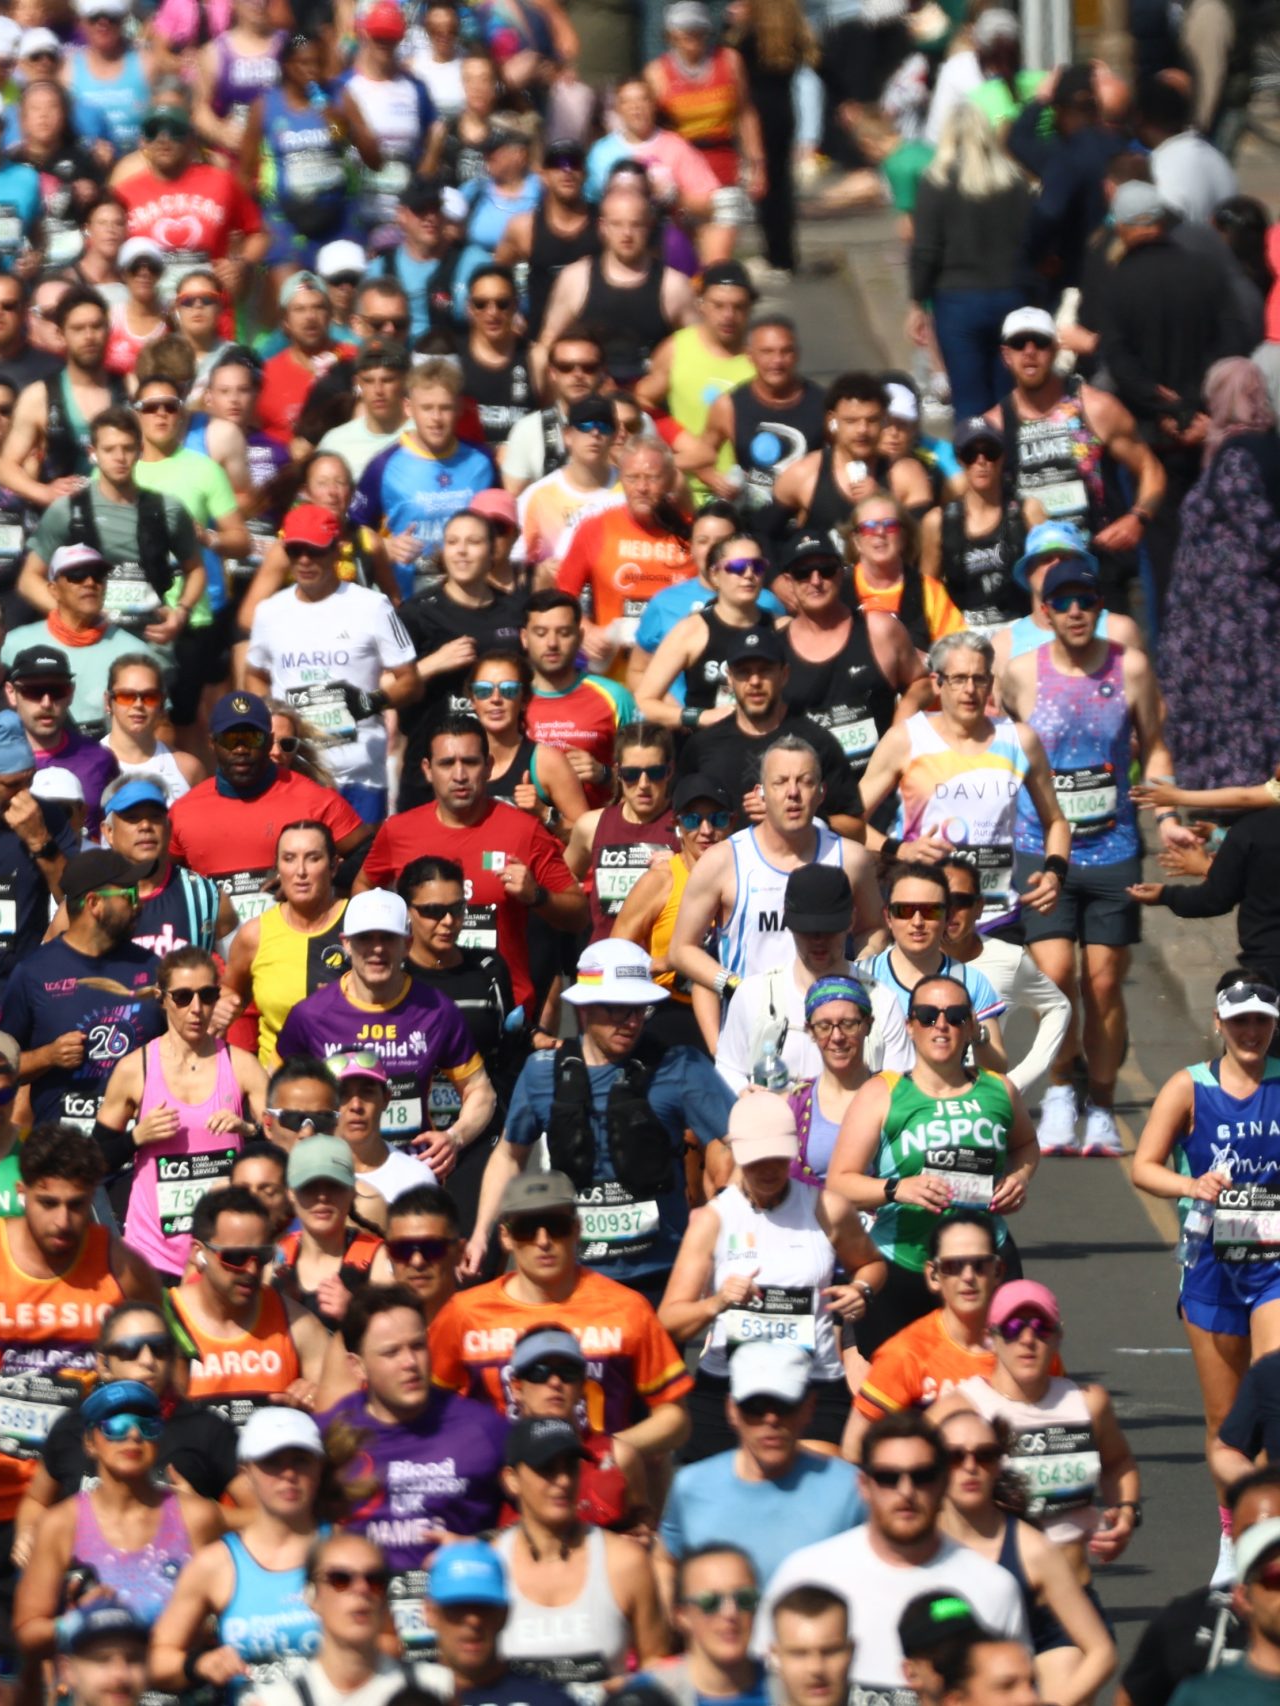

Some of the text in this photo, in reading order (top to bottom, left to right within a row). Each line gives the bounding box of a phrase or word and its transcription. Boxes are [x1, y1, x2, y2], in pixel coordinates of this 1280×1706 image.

[282, 650, 350, 669] MARIO
[287, 691, 309, 705] tcs
[450, 695, 473, 710] tc
[535, 730, 598, 738] Air Ambulance
[935, 780, 1018, 800] DAVID
[1054, 775, 1075, 790] cs
[601, 849, 627, 866] tcs
[356, 1023, 397, 1040] JOE
[89, 1024, 129, 1060] 26
[325, 1042, 407, 1058] WChild
[65, 1094, 95, 1117] tcs
[933, 1098, 982, 1118] JEN
[900, 1117, 1008, 1157] NSPCC
[1216, 1119, 1280, 1140] GINA
[191, 1154, 210, 1162] TATA
[192, 1158, 234, 1169] CONSULTANCY
[926, 1148, 957, 1167] tcs
[160, 1161, 190, 1180] tcs
[192, 1166, 219, 1177] SERVICES
[1218, 1188, 1250, 1208] tcs
[584, 1209, 643, 1233] 80937
[766, 1288, 786, 1296] TATA
[766, 1295, 809, 1304] CONSULTANCY
[766, 1302, 794, 1310] SERVICES
[1020, 1433, 1047, 1450] cs
[388, 1458, 456, 1478] Blood
